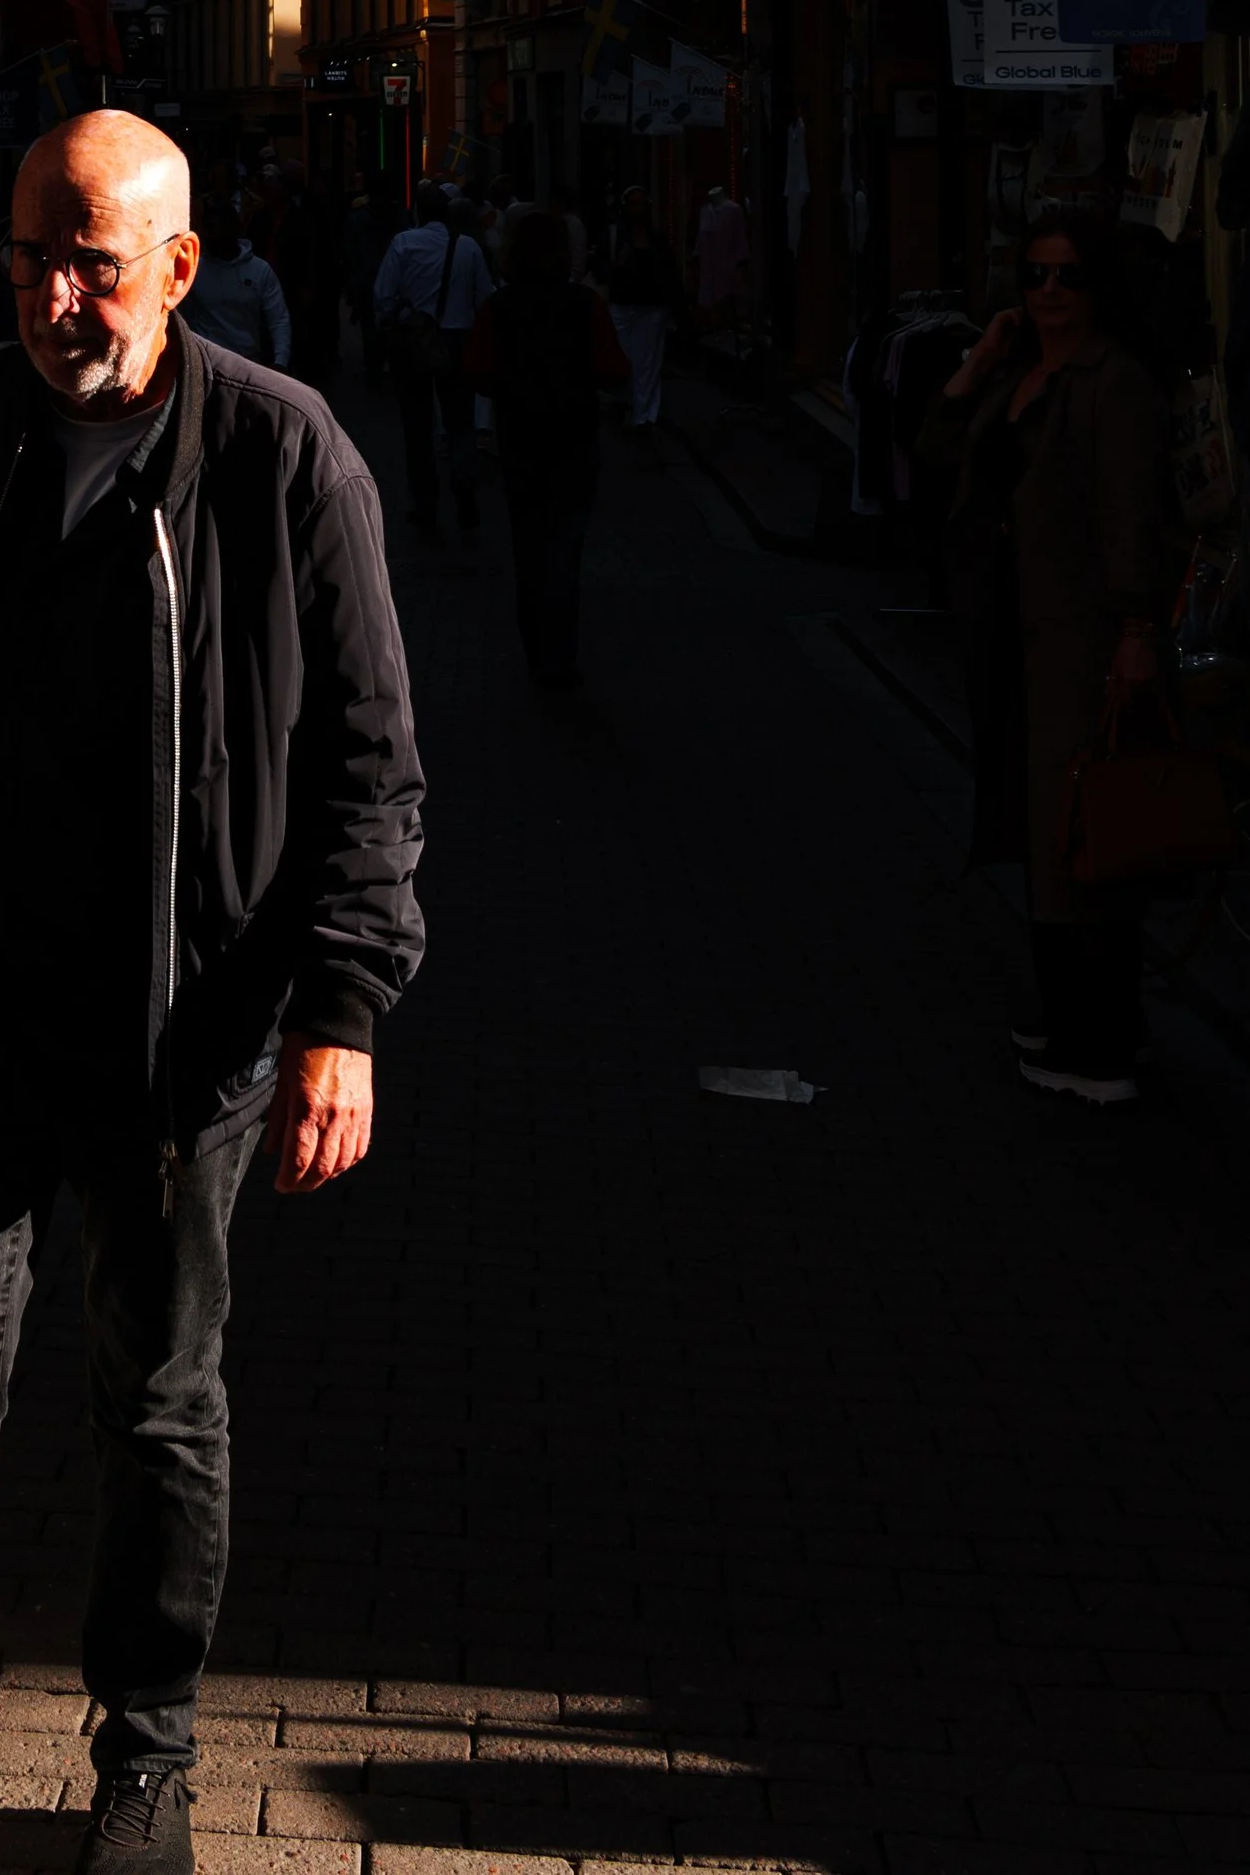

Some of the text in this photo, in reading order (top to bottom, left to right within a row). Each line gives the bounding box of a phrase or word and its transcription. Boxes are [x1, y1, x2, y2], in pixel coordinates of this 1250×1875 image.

[1011, 22, 1057, 41] Fre
[995, 65, 1103, 79] Global Blue
[387, 78, 407, 106] 7
[648, 89, 670, 107] IND
